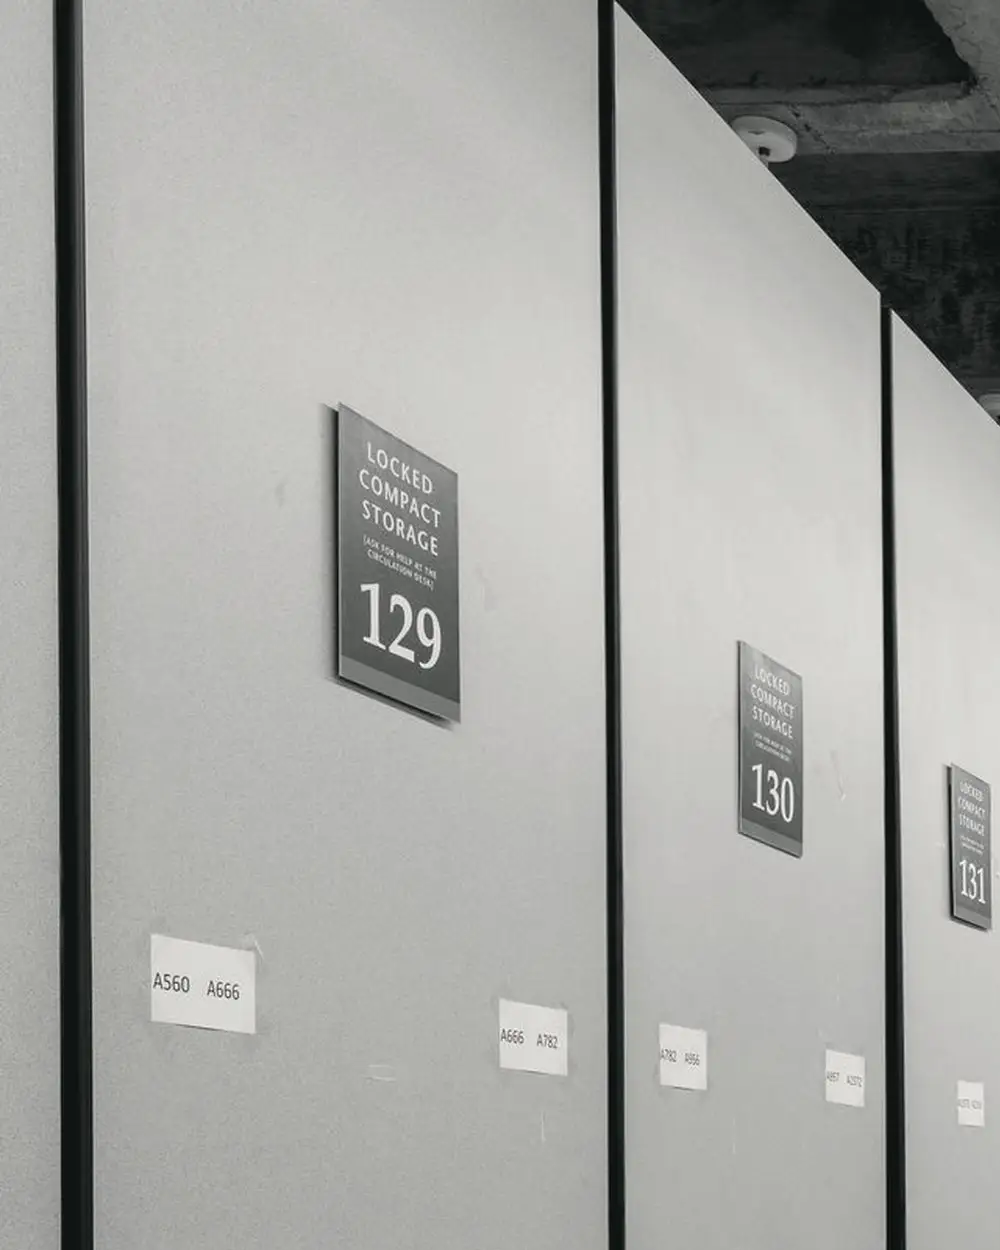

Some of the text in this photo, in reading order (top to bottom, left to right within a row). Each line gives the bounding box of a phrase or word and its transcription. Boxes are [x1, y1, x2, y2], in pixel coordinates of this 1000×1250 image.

[367, 441, 433, 494] LOCKED
[359, 468, 441, 528] COMPACT
[362, 499, 438, 556] STORAGE
[367, 548, 413, 577] CIRCULATION
[395, 551, 413, 566] HELP
[424, 565, 437, 580] THE
[360, 582, 442, 670] 129
[754, 664, 790, 697] LOCKED
[751, 683, 795, 720] COMPACT
[751, 705, 793, 739] STORAGE
[751, 763, 794, 824] 130
[959, 858, 986, 904] 131
[153, 972, 240, 1001] A560 A666
[500, 1027, 559, 1050] A666 A782
